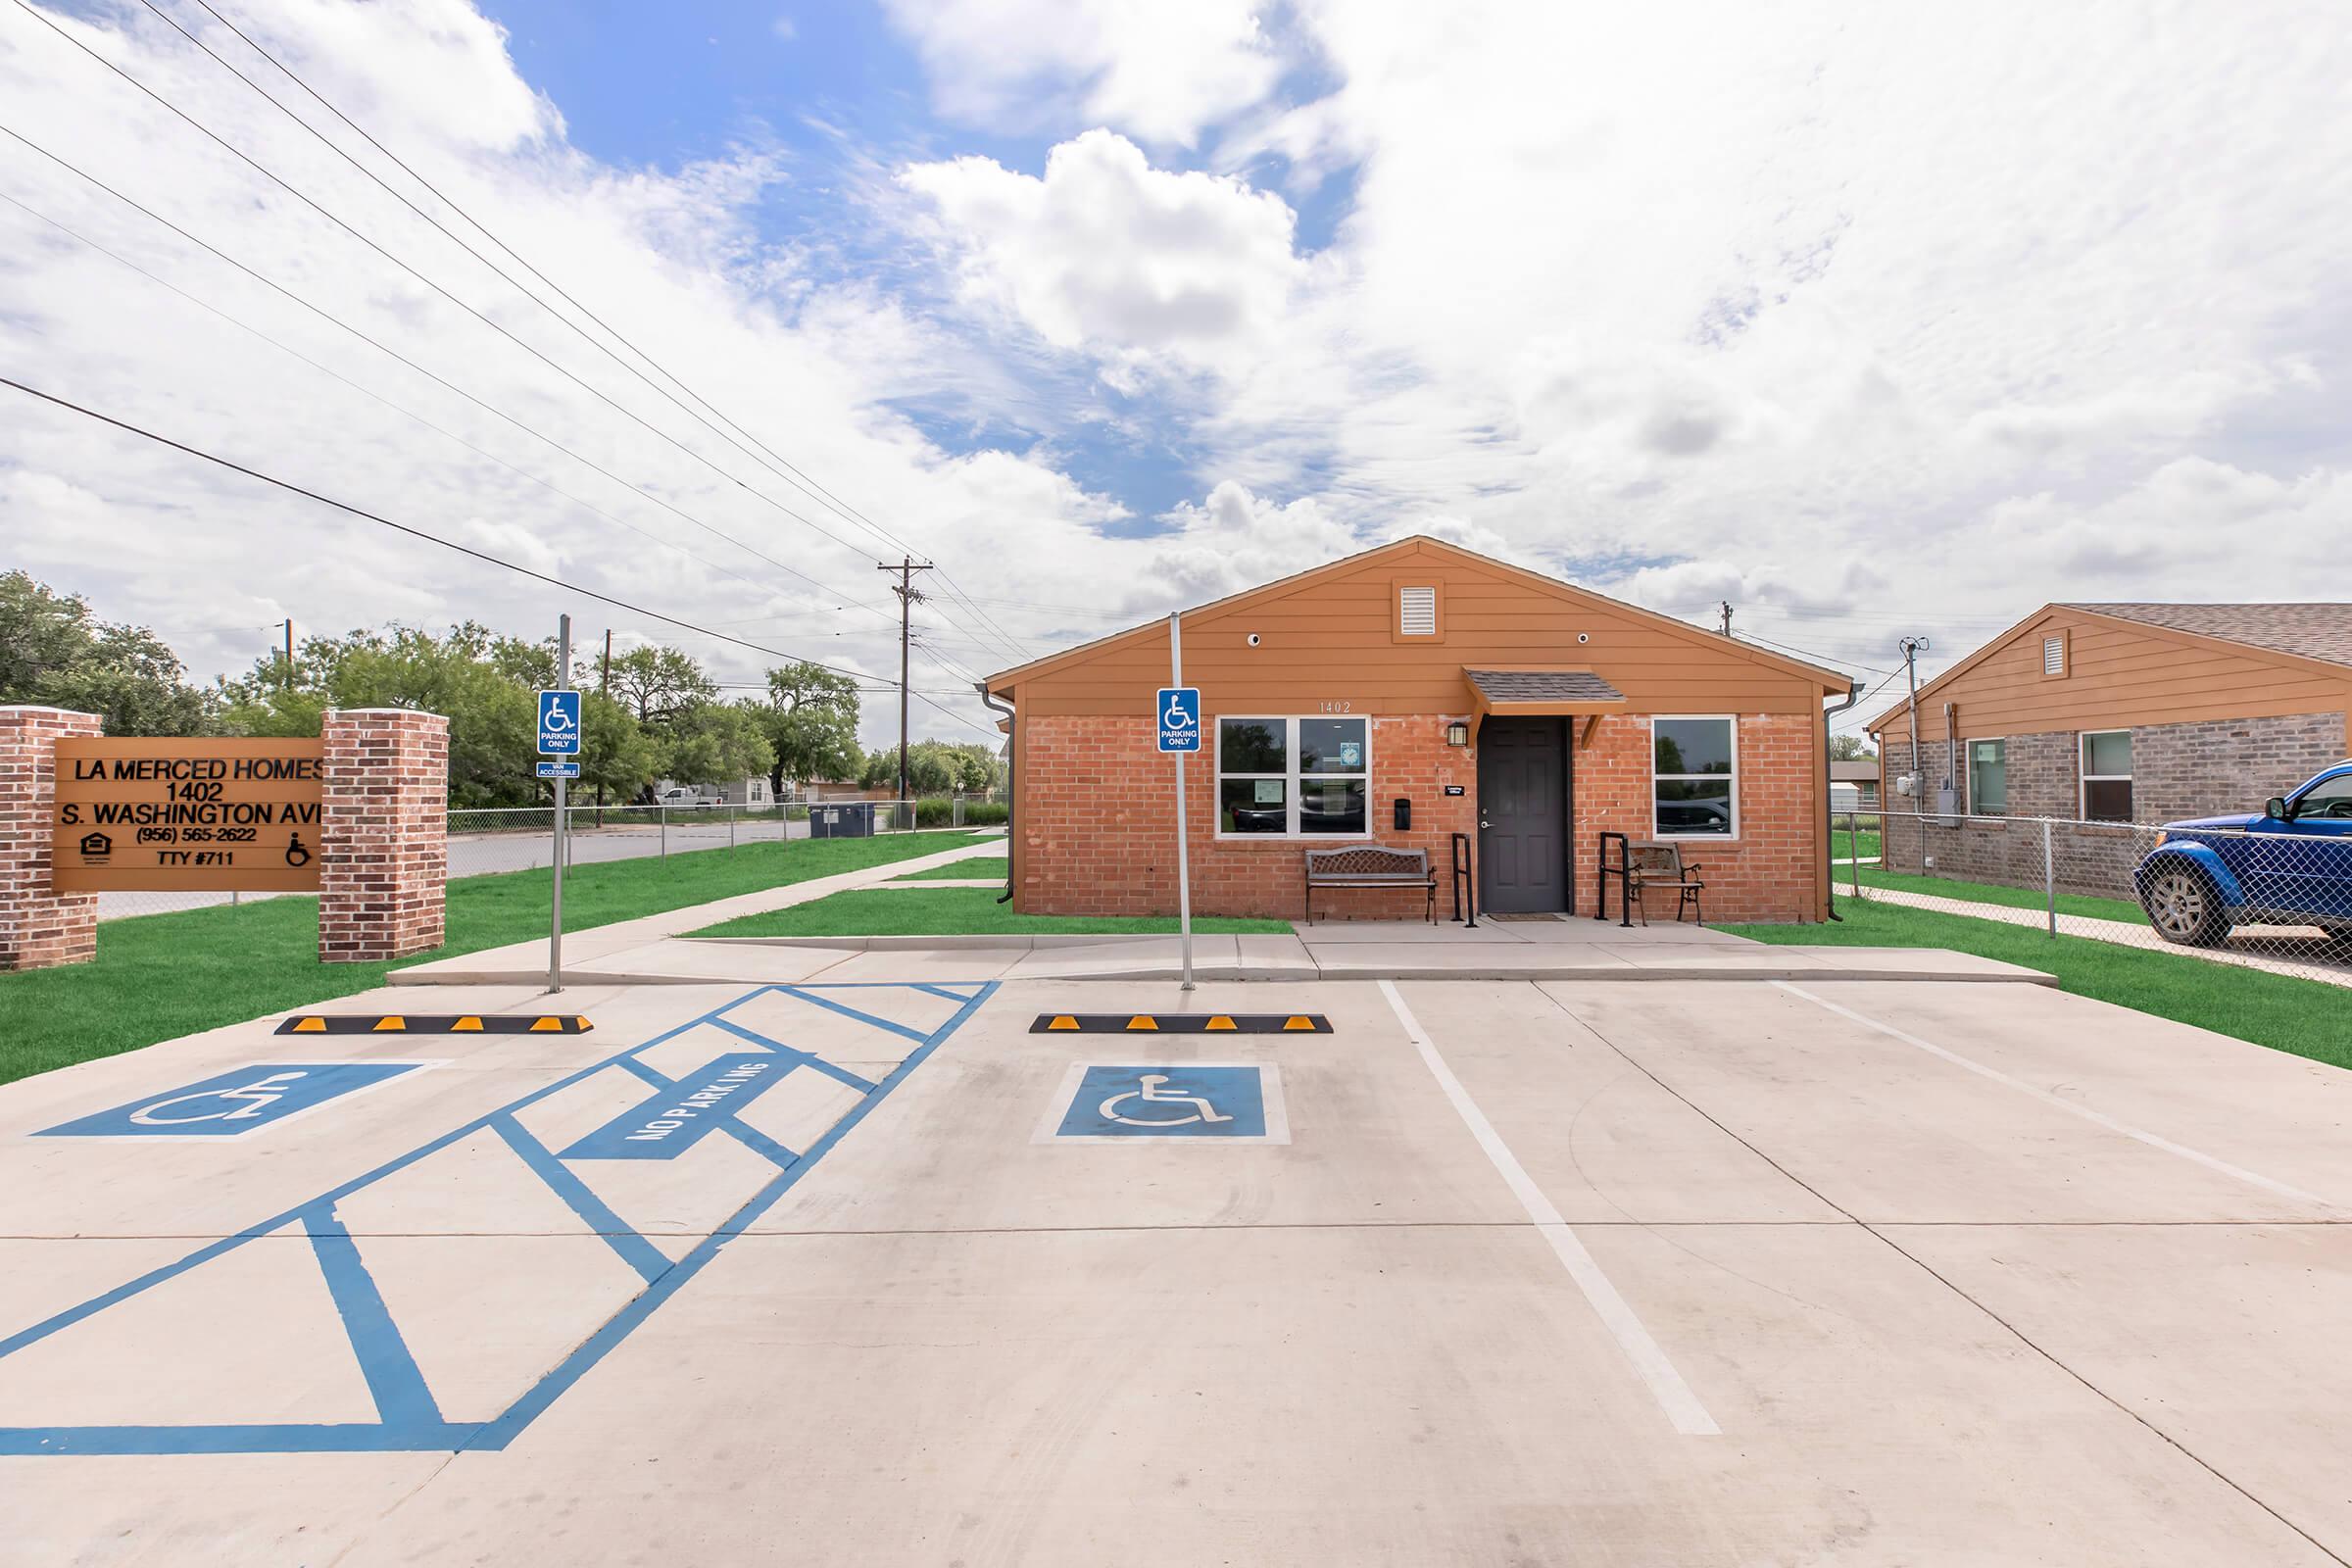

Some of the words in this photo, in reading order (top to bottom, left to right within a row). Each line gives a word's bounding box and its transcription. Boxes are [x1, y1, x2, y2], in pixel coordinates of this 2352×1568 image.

[1319, 701, 1350, 713] 1402
[75, 760, 106, 780] LA
[114, 760, 226, 780] MERCED
[167, 782, 223, 802] 1402
[61, 804, 84, 824] S.
[93, 804, 272, 824] WASHINGTON
[137, 827, 176, 844] (956)
[181, 828, 257, 841] 565-2622
[157, 851, 191, 864] TTY
[195, 851, 233, 865] #711
[624, 1120, 684, 1141] NO
